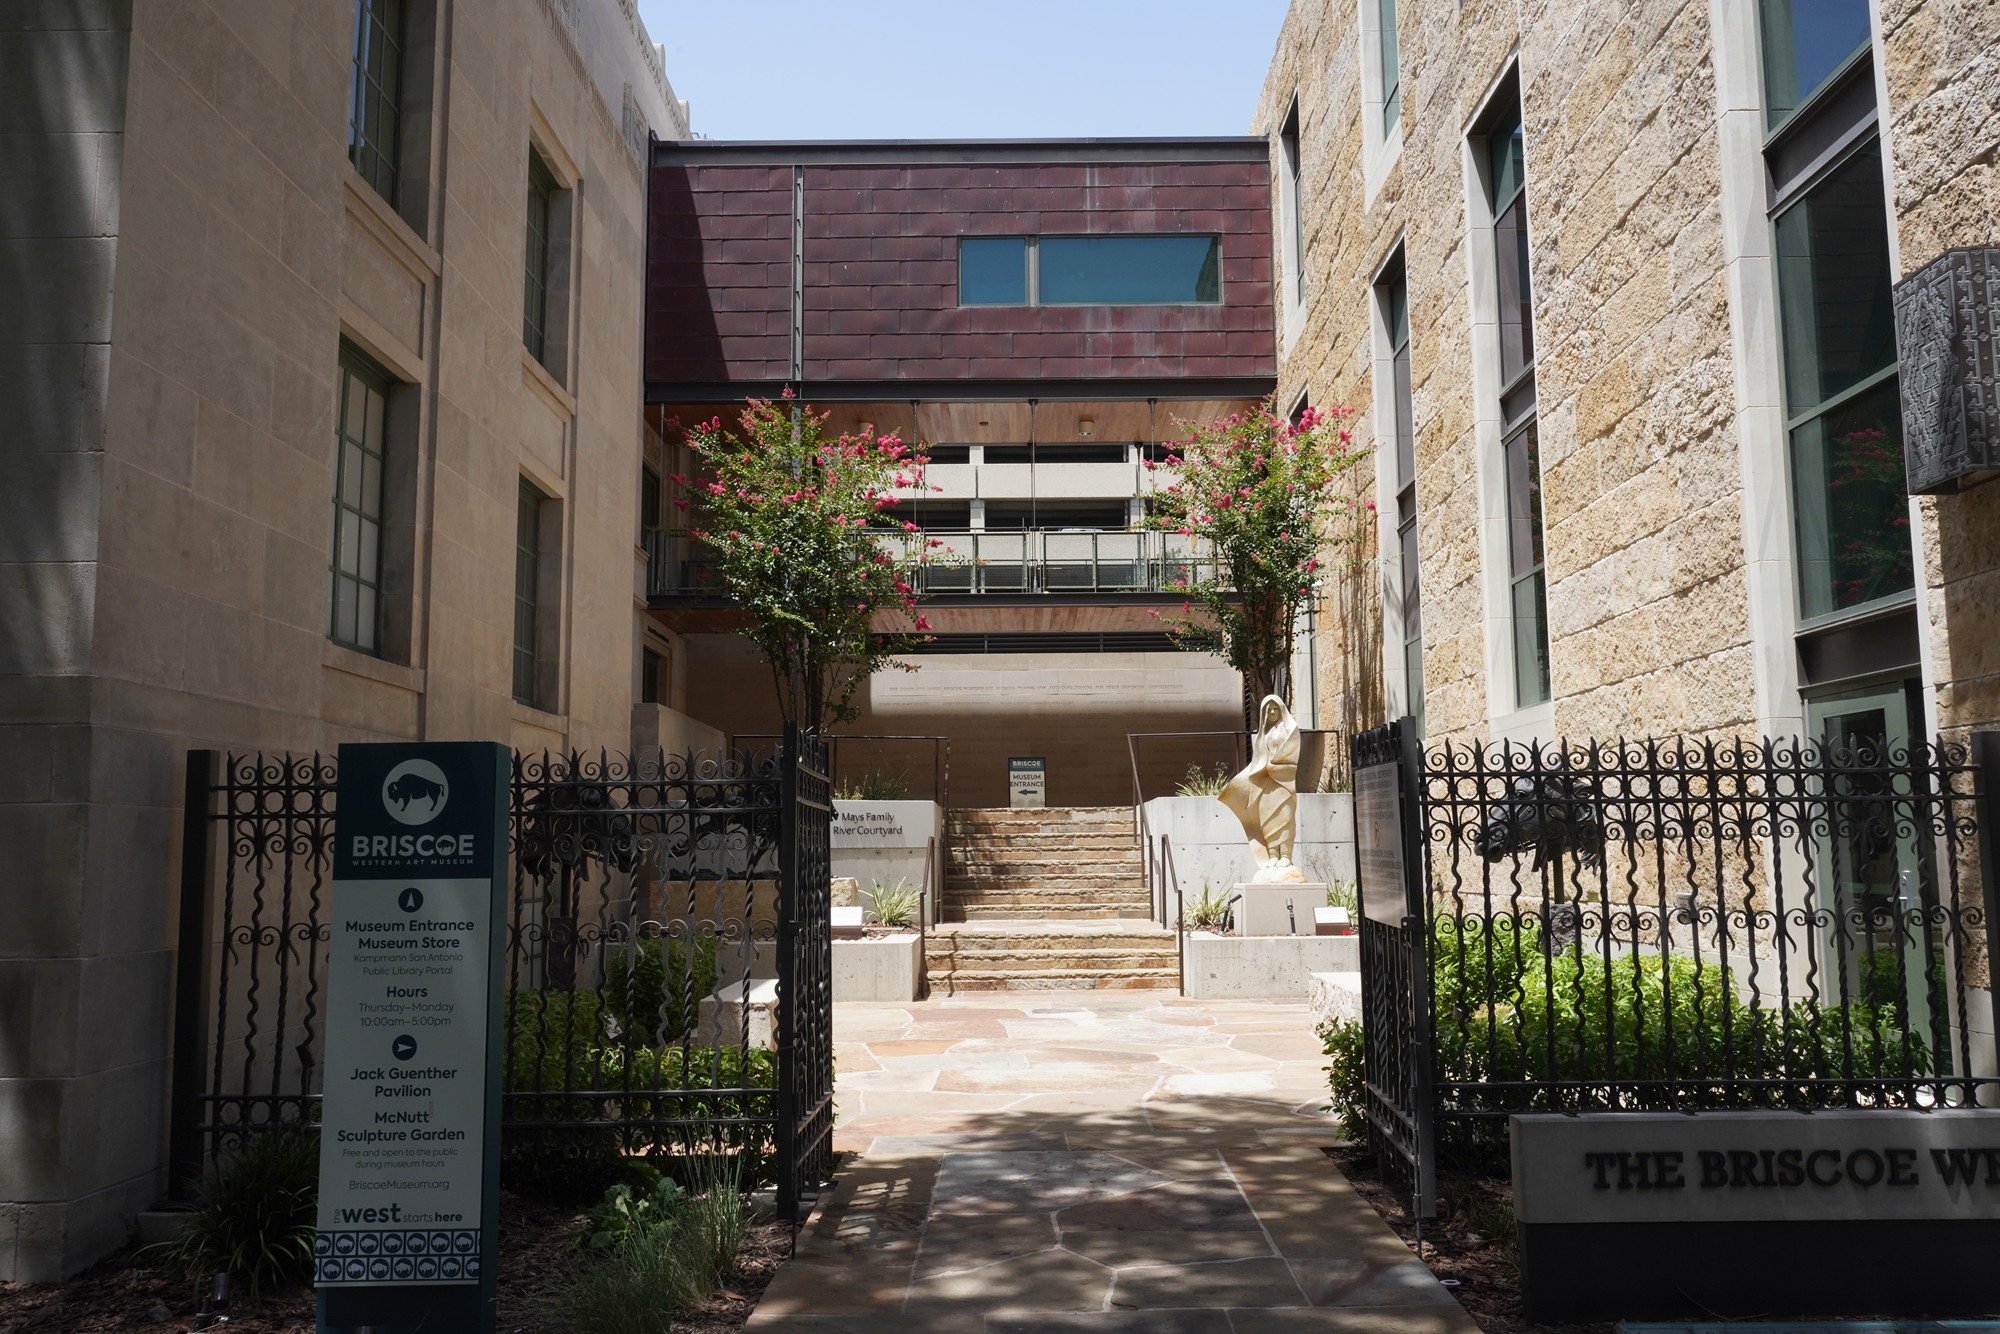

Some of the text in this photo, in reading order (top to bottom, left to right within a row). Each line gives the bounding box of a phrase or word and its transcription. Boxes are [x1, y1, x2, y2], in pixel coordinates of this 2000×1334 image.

[842, 812, 895, 824] Mays Family
[833, 826, 903, 838] River Courtyard
[352, 834, 474, 857] BRISCOE
[345, 920, 475, 932] Museum Entrance
[358, 937, 460, 949] Museum Store
[354, 953, 464, 964] Kampmann San Antonio
[362, 966, 453, 976] Public Library Portal
[386, 986, 428, 998] Hours
[350, 1066, 458, 1080] Jack Guenther
[374, 1085, 432, 1098] Pavilion
[374, 1111, 430, 1124] McNutt
[337, 1128, 465, 1144] Sculpture Garden
[342, 1149, 361, 1157] Free
[362, 1149, 380, 1157] and
[381, 1150, 404, 1158] open
[416, 1148, 432, 1156] the
[432, 1148, 458, 1158] public
[354, 1160, 382, 1170] during
[422, 1160, 446, 1168] hours
[1585, 1151, 1685, 1189] THE
[1698, 1148, 1919, 1188] BRISCOE
[349, 1180, 450, 1191] BriscoeMuseum.org
[341, 1203, 402, 1224] west
[402, 1212, 434, 1222] starts
[434, 1212, 463, 1222] here
